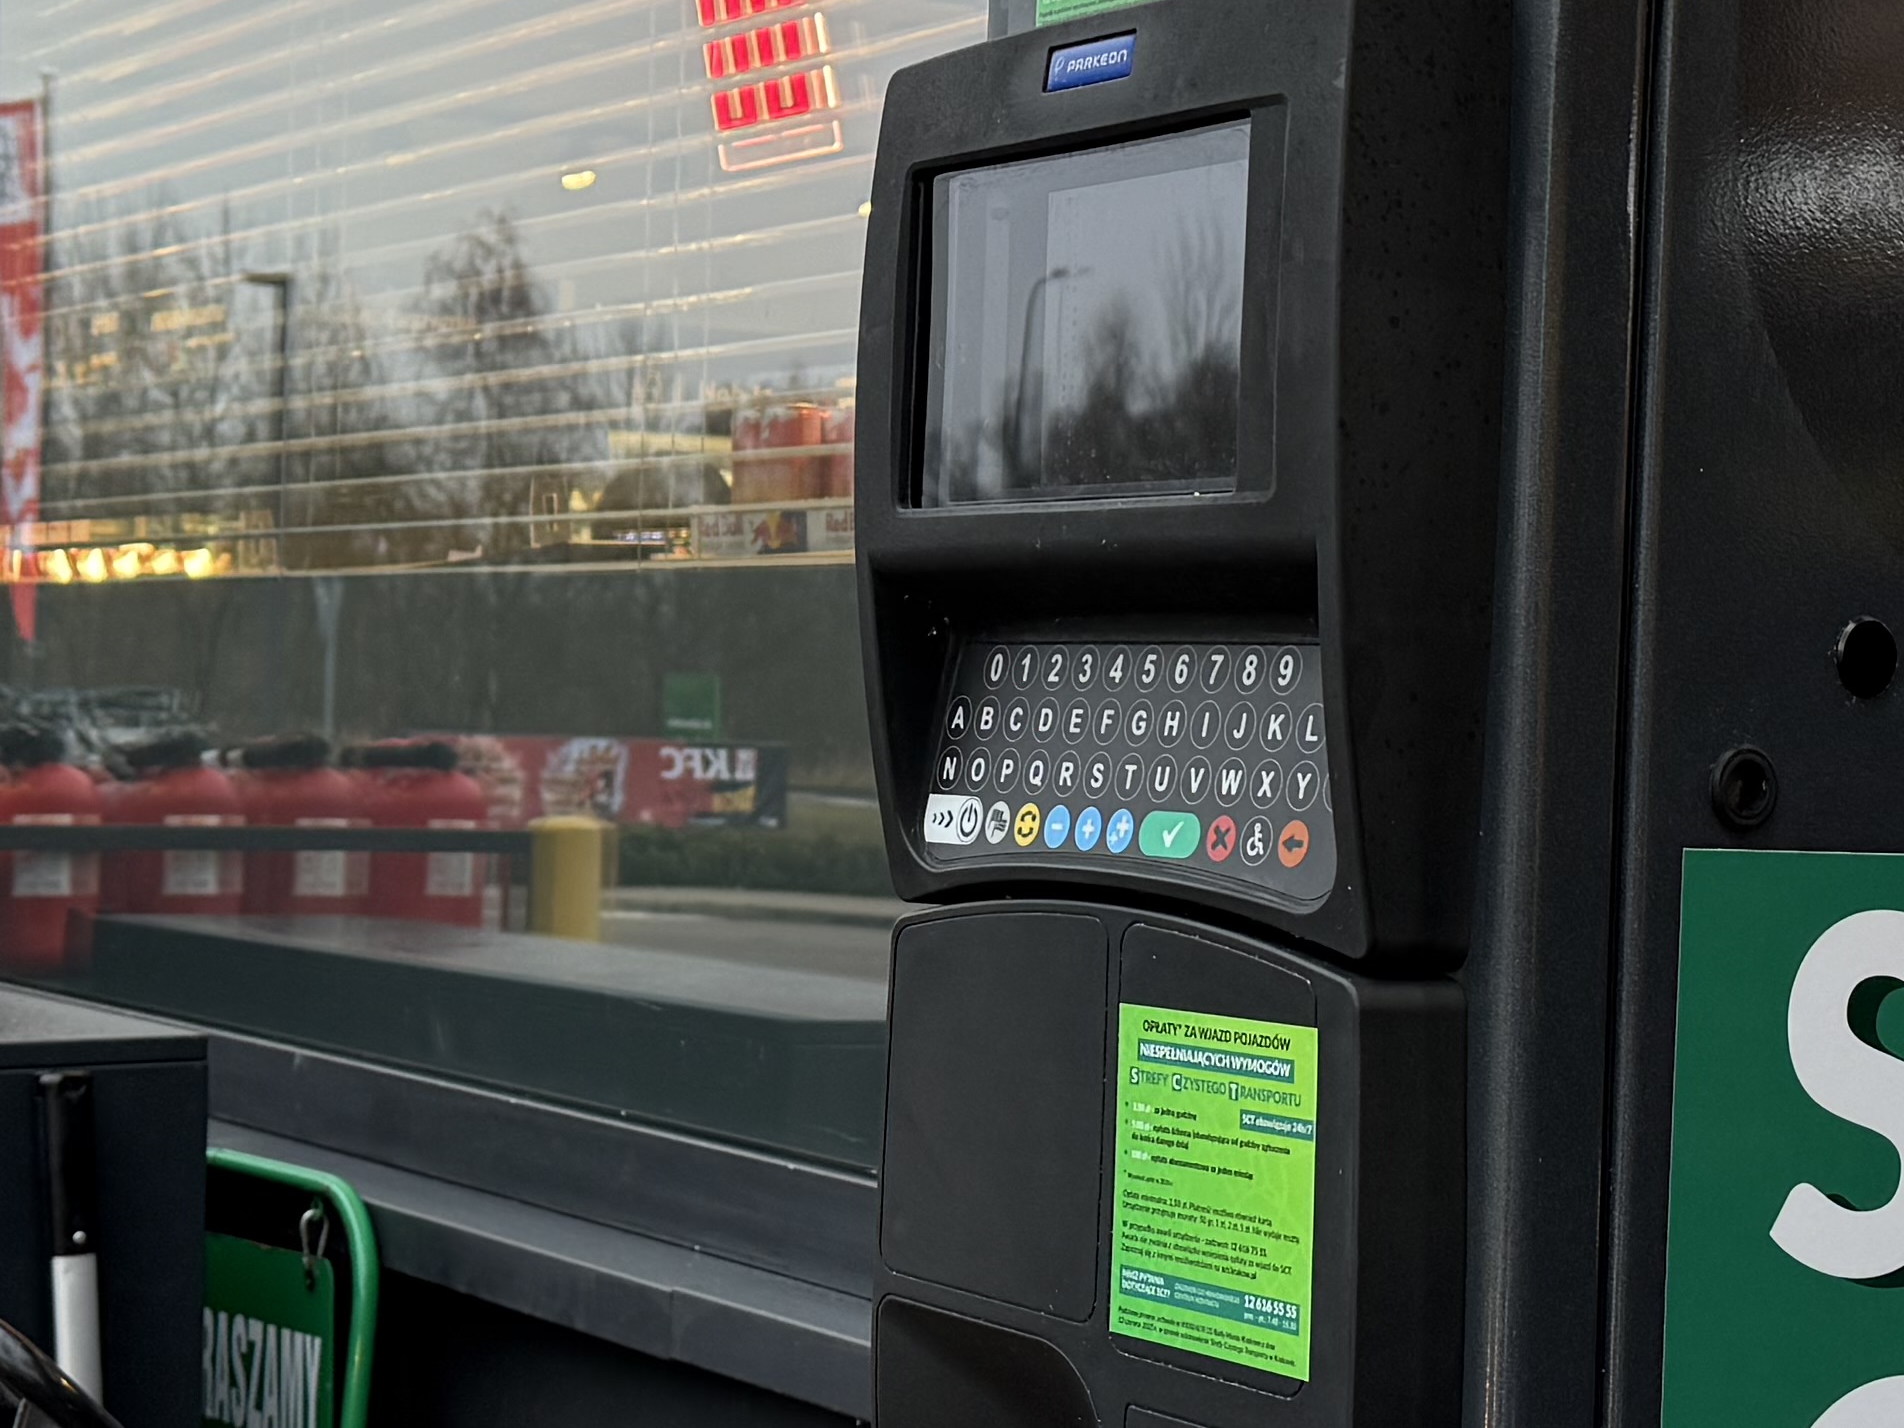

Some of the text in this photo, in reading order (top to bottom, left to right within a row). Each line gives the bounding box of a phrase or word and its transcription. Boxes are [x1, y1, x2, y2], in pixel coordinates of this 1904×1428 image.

[990, 653, 1294, 686] 0 1 2 3 4 5 6 7 8 9
[951, 705, 1318, 742] A B C D E F G H I J K L
[943, 756, 1312, 800] N O P Q R S T U V W X Y
[1184, 1024, 1196, 1039] ZA
[1199, 1027, 1232, 1043] WJAZD
[1233, 1031, 1291, 1052] POJAZDÓW
[1230, 1056, 1291, 1078] WYMOGÓW
[1129, 1067, 1302, 1108] STREFY CZYSTEGO TRANSPORTU
[1244, 1295, 1255, 1309] 12
[1273, 1302, 1285, 1317] 55
[1285, 1305, 1298, 1319] 55
